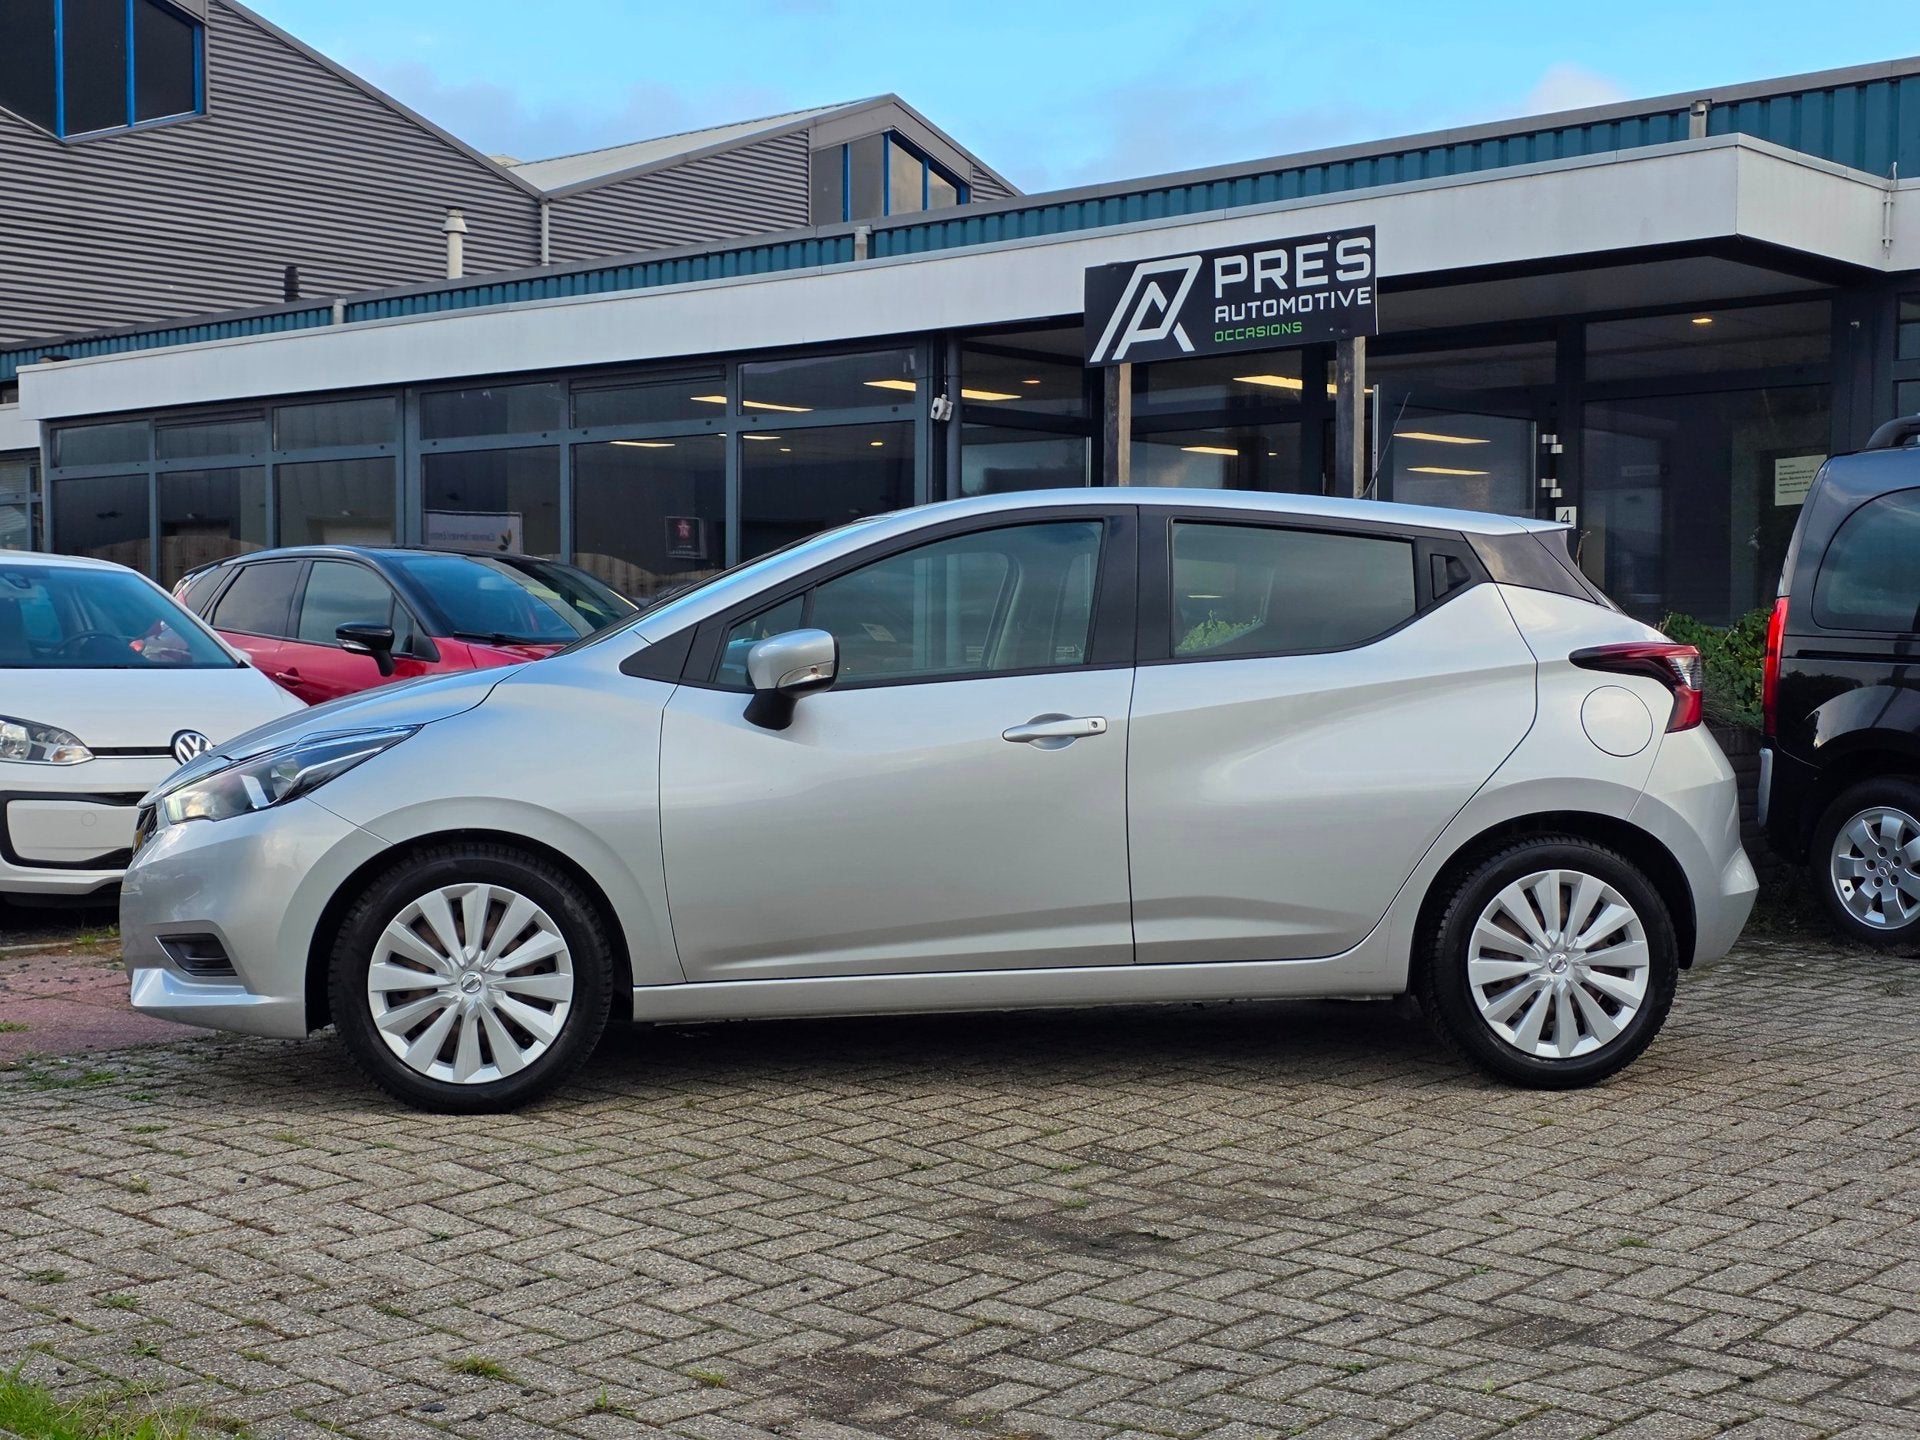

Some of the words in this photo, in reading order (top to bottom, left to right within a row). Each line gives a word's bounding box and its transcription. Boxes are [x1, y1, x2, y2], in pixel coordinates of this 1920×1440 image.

[1214, 237, 1371, 299] PRES
[1215, 286, 1371, 323] AUTOMOTIVE
[1215, 321, 1303, 343] OCCASIONS
[1560, 509, 1571, 523] 4
